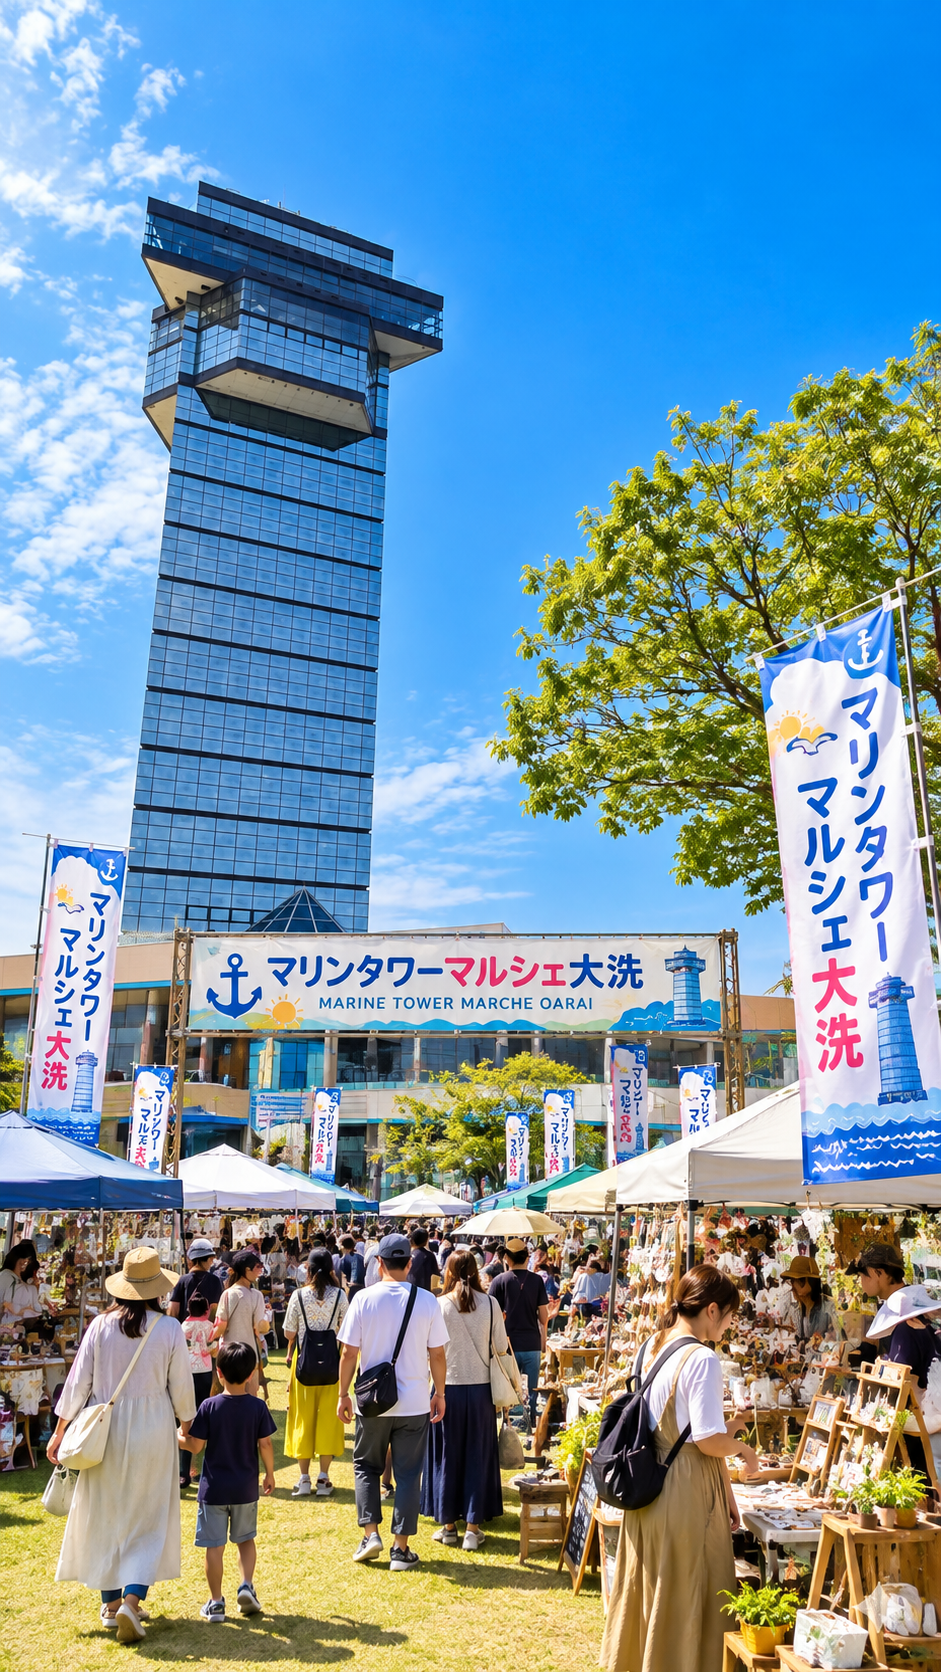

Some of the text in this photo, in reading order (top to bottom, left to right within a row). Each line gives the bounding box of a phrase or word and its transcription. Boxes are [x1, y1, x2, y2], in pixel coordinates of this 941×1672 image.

[842, 687, 894, 962] マリンタワー
[80, 892, 111, 1042] マリンタワー
[319, 997, 593, 1011] MARINE TOWER MARCHE OARAI
[797, 776, 865, 1073] マルシェ大洗
[41, 927, 81, 1091] マルシェ大洗
